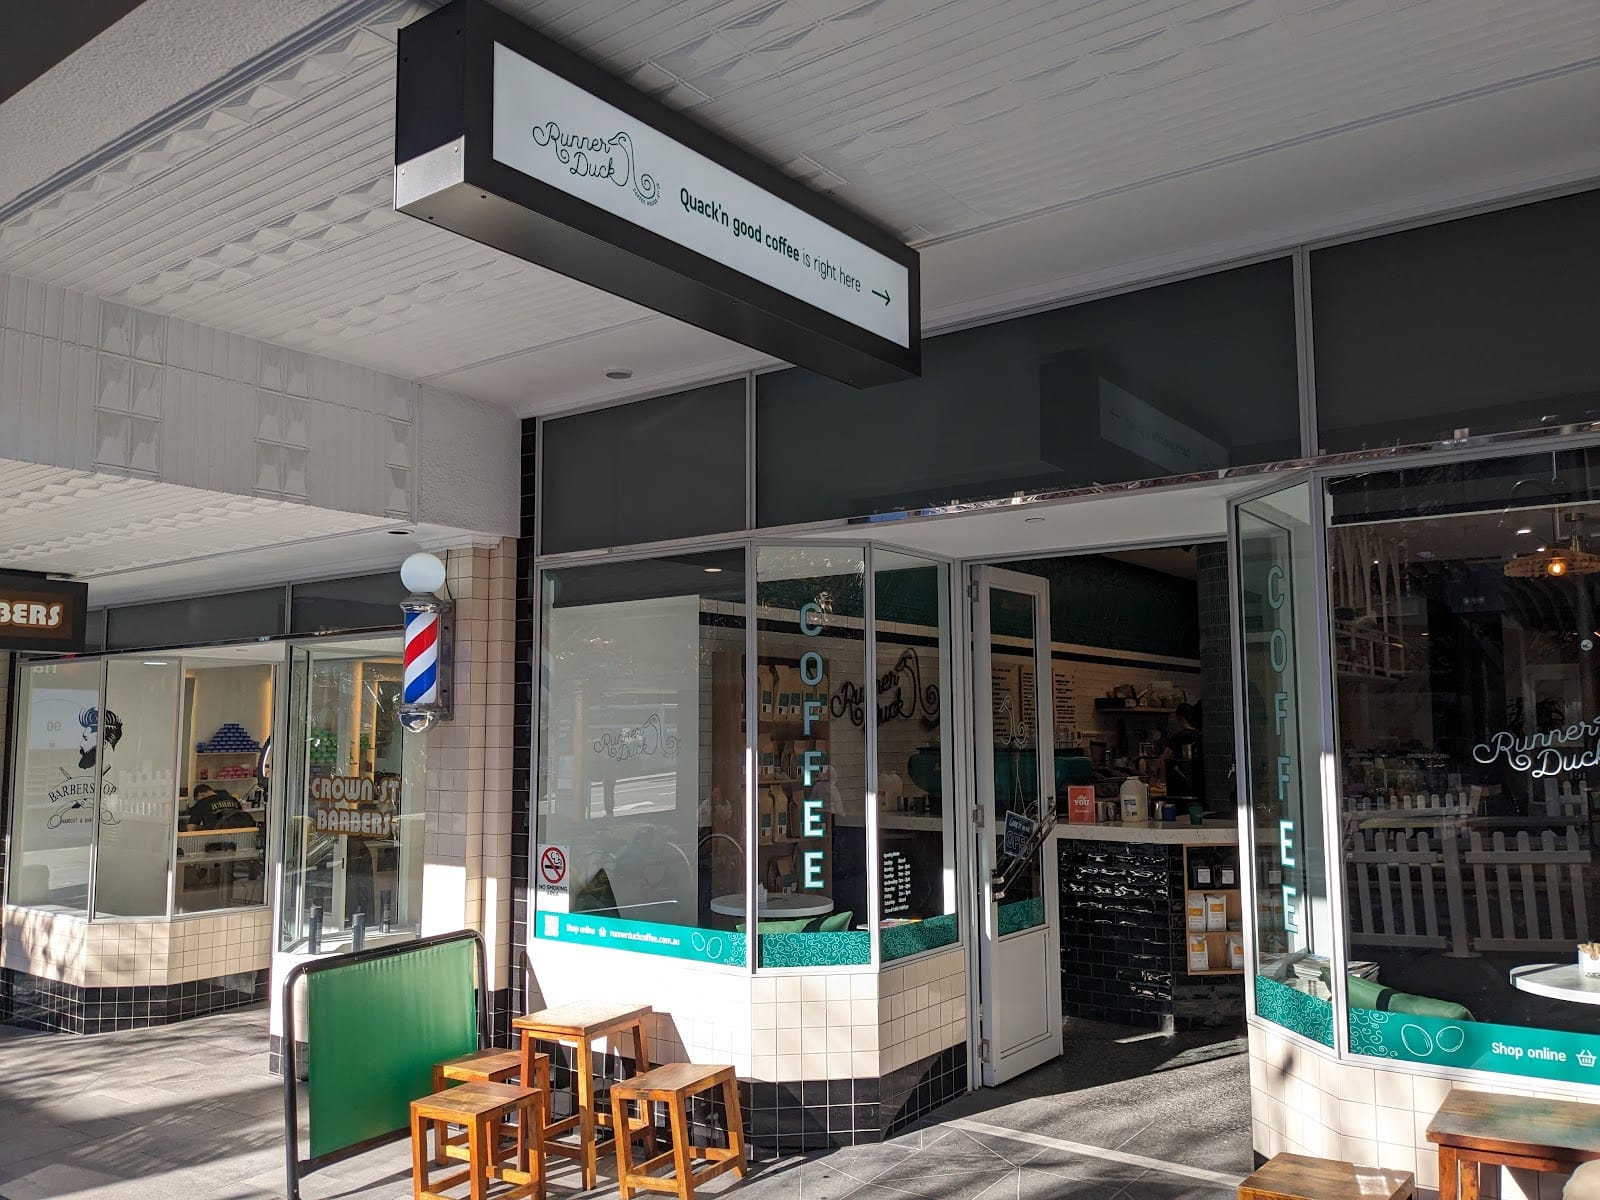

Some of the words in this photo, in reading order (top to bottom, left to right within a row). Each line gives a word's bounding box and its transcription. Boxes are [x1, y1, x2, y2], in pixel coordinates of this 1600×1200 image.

[532, 122, 611, 164] Runner
[569, 151, 615, 179] Duck
[680, 187, 729, 227] Quack'n
[733, 217, 762, 243] good
[765, 234, 800, 261] coffee
[802, 247, 811, 267] is
[813, 255, 837, 280] right
[839, 267, 861, 292] here
[800, 602, 824, 889] COFFEE
[1268, 564, 1299, 934] COFFEE
[1472, 721, 1599, 771] Runner
[48, 783, 117, 803] BARBERSOP
[311, 777, 373, 802] CROWN
[380, 779, 400, 802] ST
[316, 808, 392, 836] BARBERS
[566, 923, 579, 934] Shop
[1491, 1042, 1524, 1060] Shop
[1527, 1046, 1567, 1062] online
